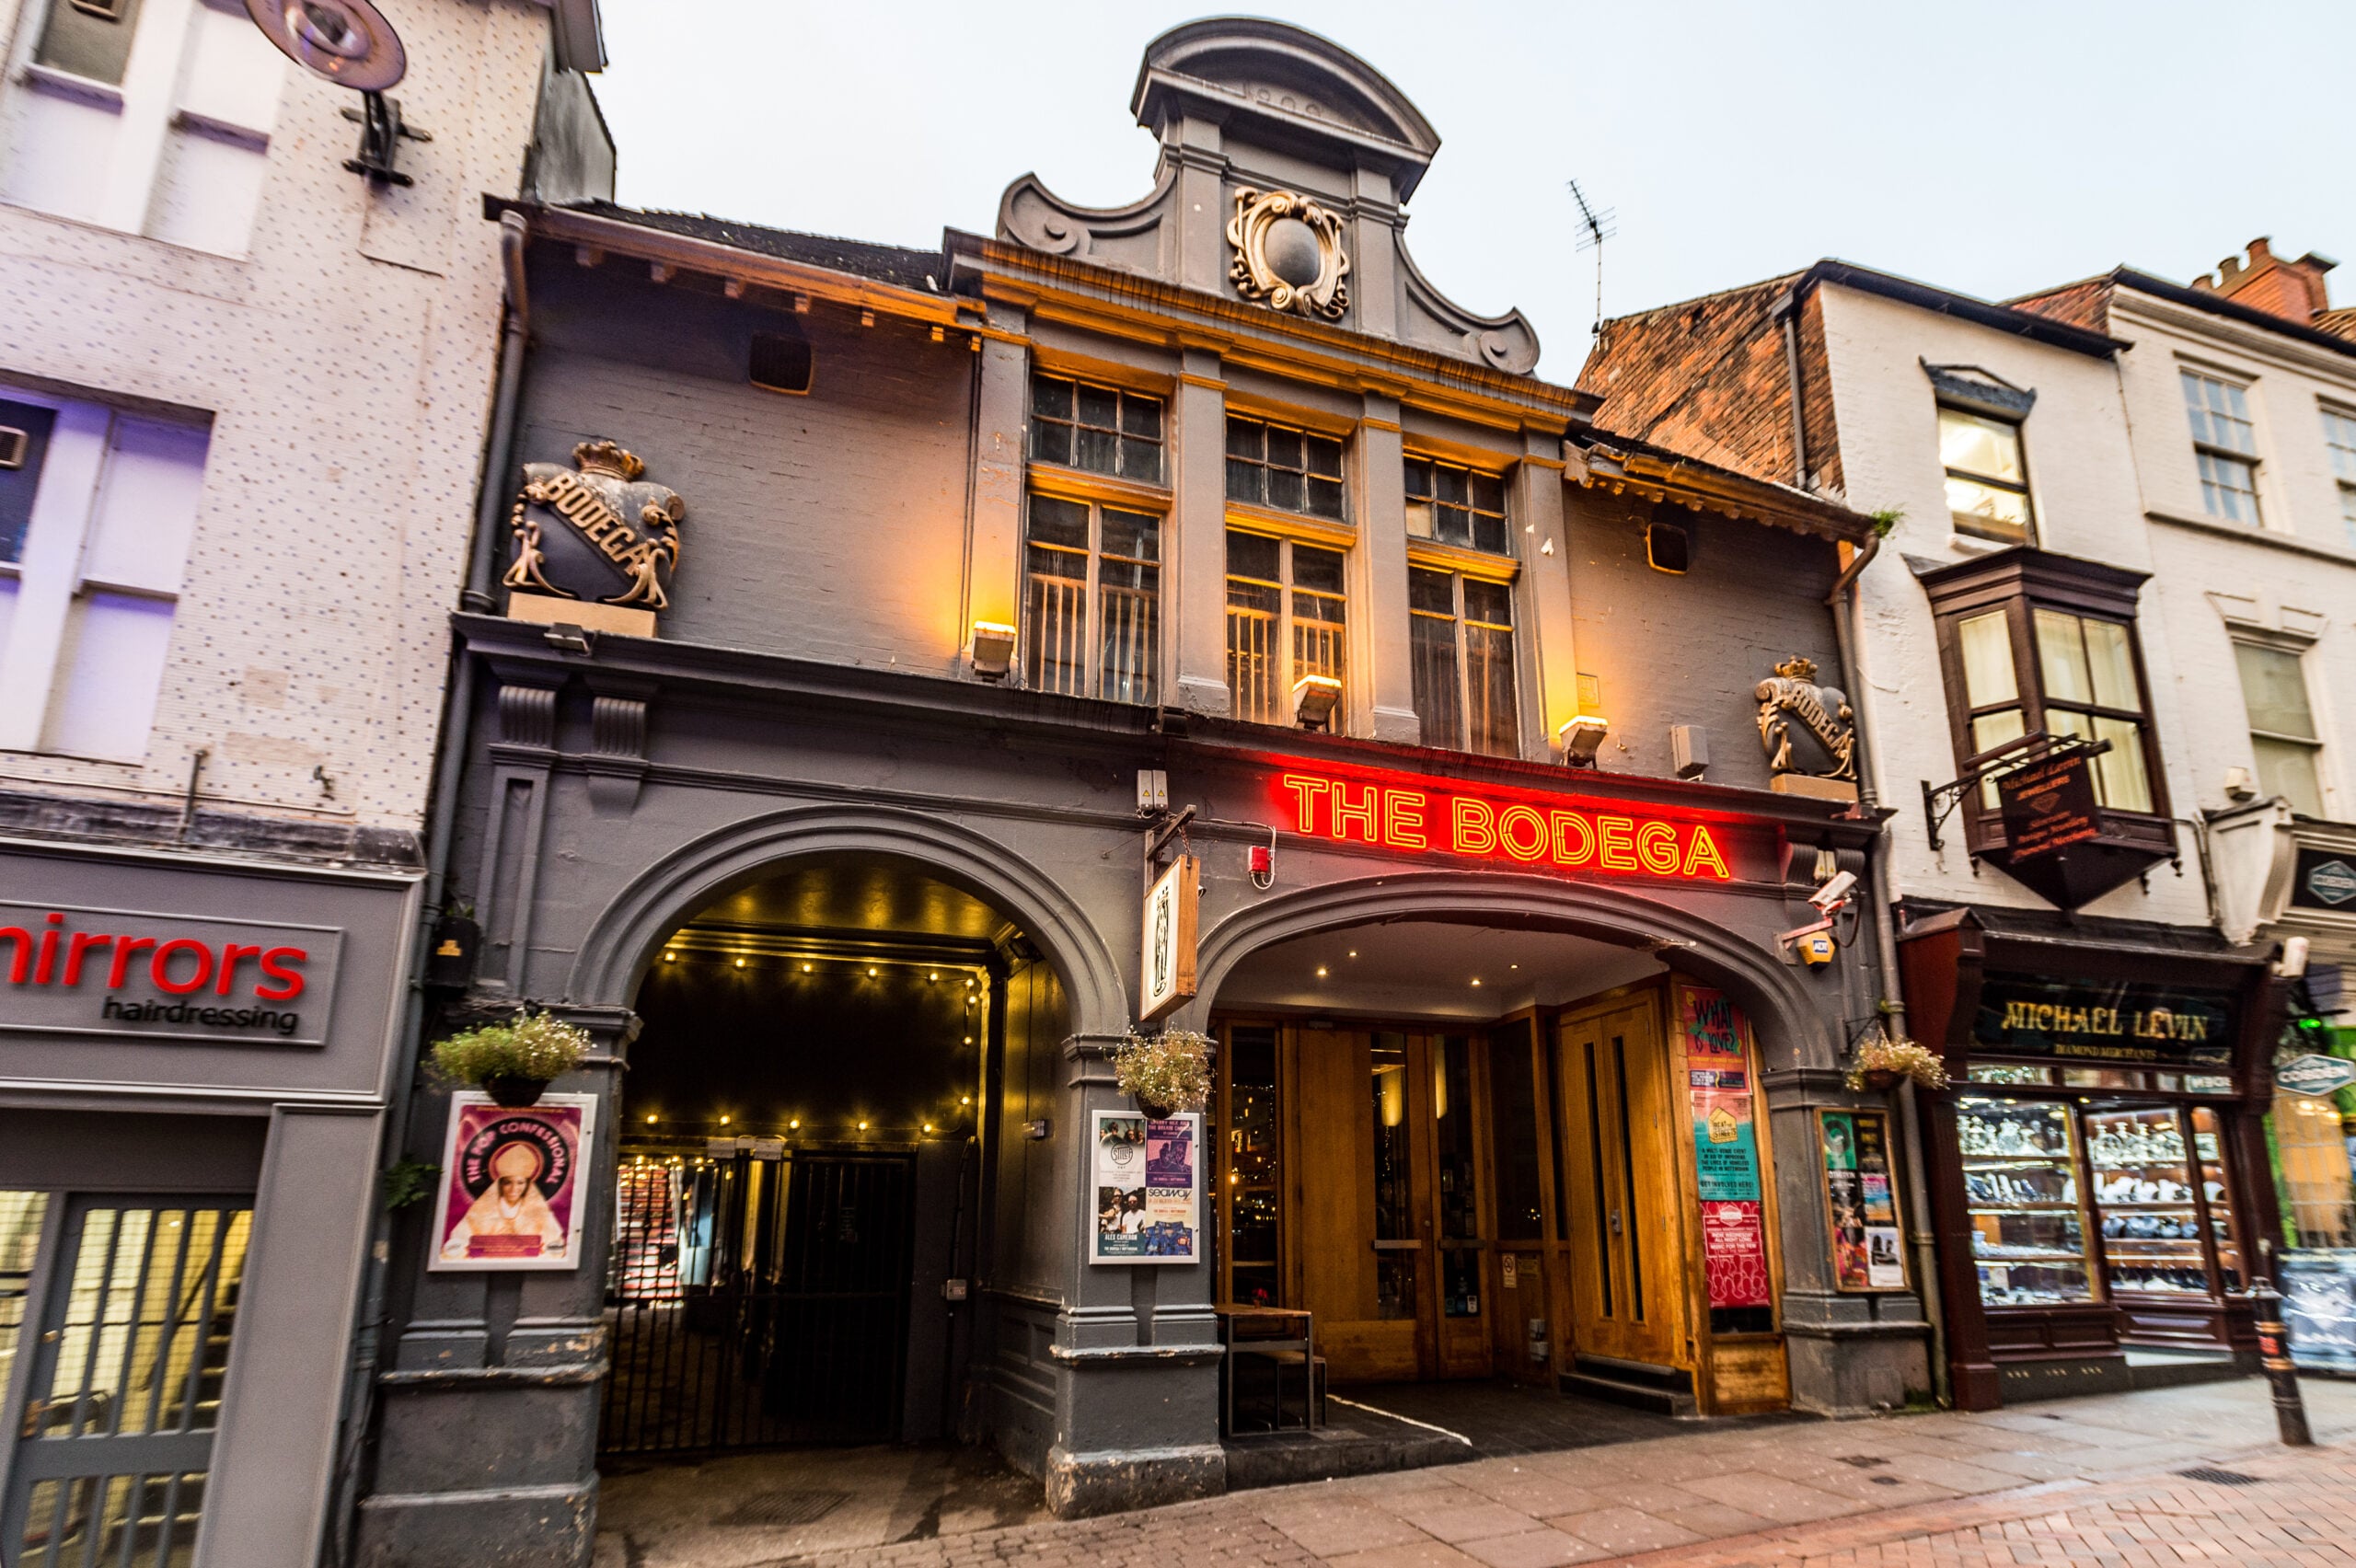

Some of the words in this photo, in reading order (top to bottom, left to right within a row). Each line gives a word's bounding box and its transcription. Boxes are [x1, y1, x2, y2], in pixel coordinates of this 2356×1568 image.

[545, 472, 648, 576] BODEGA
[1791, 686, 1848, 756] BODEGA
[1283, 774, 1426, 849] THE
[1451, 795, 1730, 879] BODEGA
[1814, 942, 1828, 952] ADT
[101, 996, 300, 1034] hairdressing
[1693, 999, 1732, 1030] WHAT
[2001, 1001, 2122, 1034] MICHAEL
[2134, 1009, 2209, 1040] LEVIN
[2055, 1043, 2098, 1056] DIAMOND
[2099, 1046, 2157, 1059] MERCHANTS
[467, 1159, 481, 1183] THE
[499, 1122, 566, 1183] CONFESSIONAL
[1148, 1188, 1192, 1201] seaway
